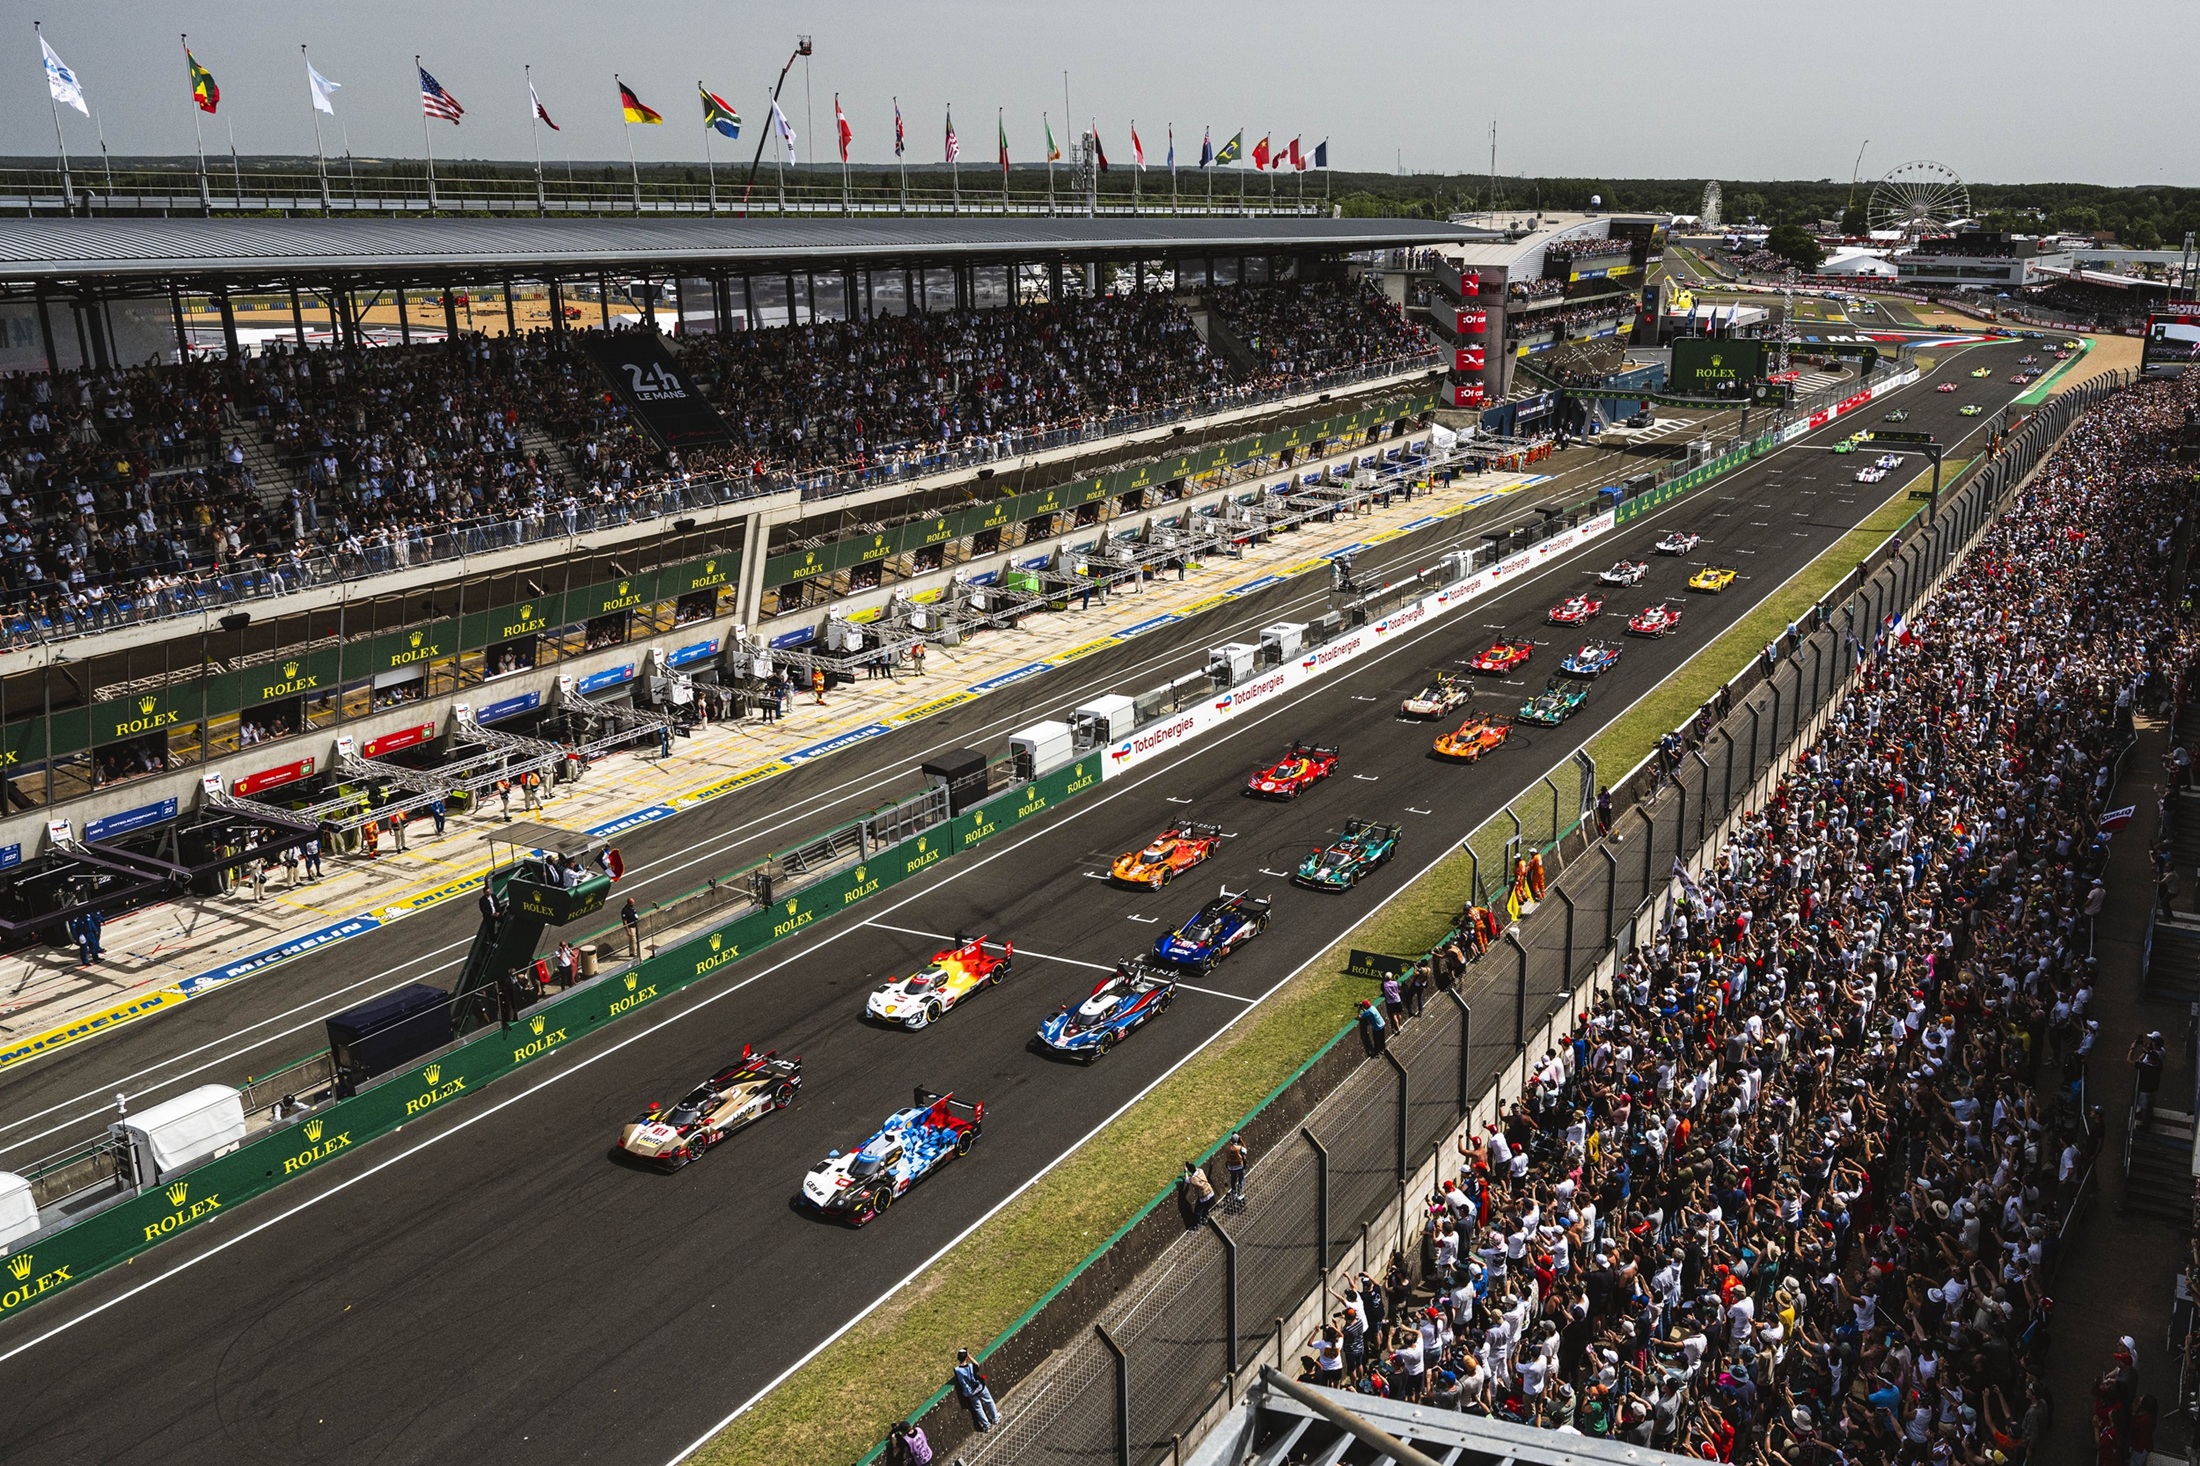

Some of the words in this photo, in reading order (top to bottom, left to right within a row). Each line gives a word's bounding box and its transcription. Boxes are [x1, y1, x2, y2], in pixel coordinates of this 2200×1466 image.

[621, 362, 681, 392] 24h
[1696, 369, 1736, 378] ROLEX
[636, 392, 653, 401] LE
[654, 390, 686, 400] MANS
[1248, 447, 1262, 457] ROLEX
[1286, 439, 1299, 447] ROLEX
[1212, 456, 1229, 467] ROLEX
[1173, 466, 1191, 478] ROLEX
[1132, 477, 1149, 488] ROLEX
[1086, 488, 1105, 501] ROLEX
[1038, 500, 1058, 512] ROLEX
[985, 514, 1006, 529] ROLEX
[927, 529, 951, 543] ROLEX
[1549, 537, 1572, 551] TotalEnergies
[863, 545, 890, 561] ROLEX
[793, 563, 822, 578] ROLEX
[1500, 557, 1529, 574] TotalEnergies
[692, 572, 727, 590] ROLEX
[1447, 581, 1480, 600] TotalEnergies
[604, 593, 642, 613] ROLEX
[504, 616, 545, 637] ROLEX
[1130, 615, 1176, 635] MICHELIN
[1388, 608, 1424, 629] TotalEnergies
[392, 643, 439, 668] ROLEX
[1063, 636, 1113, 659] MICHELIN
[1317, 639, 1360, 664] TotalEnergies
[263, 674, 317, 698] ROLEX
[988, 664, 1046, 689] MICHELIN
[1233, 675, 1284, 704] TotalEnergies
[904, 693, 968, 720] MICHELIN
[116, 709, 177, 736] ROLEX
[807, 725, 881, 757] MICHELIN
[1133, 717, 1194, 752] TotalEnergies
[0, 751, 19, 766] X
[697, 765, 778, 798] MICHELIN
[1068, 773, 1091, 793] ROLEX
[164, 806, 174, 814] 22
[1019, 796, 1045, 816] ROLEX
[593, 808, 664, 837] CHELIN
[966, 821, 994, 843] ROLEX
[4, 853, 17, 861] 222
[907, 848, 938, 872] ROLEX
[413, 875, 485, 906] MICHE
[845, 877, 878, 902] ROLEX
[523, 902, 555, 917] ROLEX
[567, 900, 603, 920] ROLEX
[774, 909, 812, 936] ROLEX
[226, 922, 363, 976] MICHELIN
[696, 944, 738, 974] ROLEX
[1351, 965, 1384, 979] ROLEX
[610, 983, 656, 1016] ROLEX
[2, 997, 164, 1063] MICHELIN
[514, 1027, 566, 1062] ROLEX
[406, 1075, 464, 1114] ROLEX
[733, 1103, 757, 1123] Hertz
[640, 1134, 664, 1147] Hertz
[284, 1130, 351, 1174] ROLEX
[144, 1193, 221, 1241] ROLEX
[0, 1264, 72, 1312] OLEX
